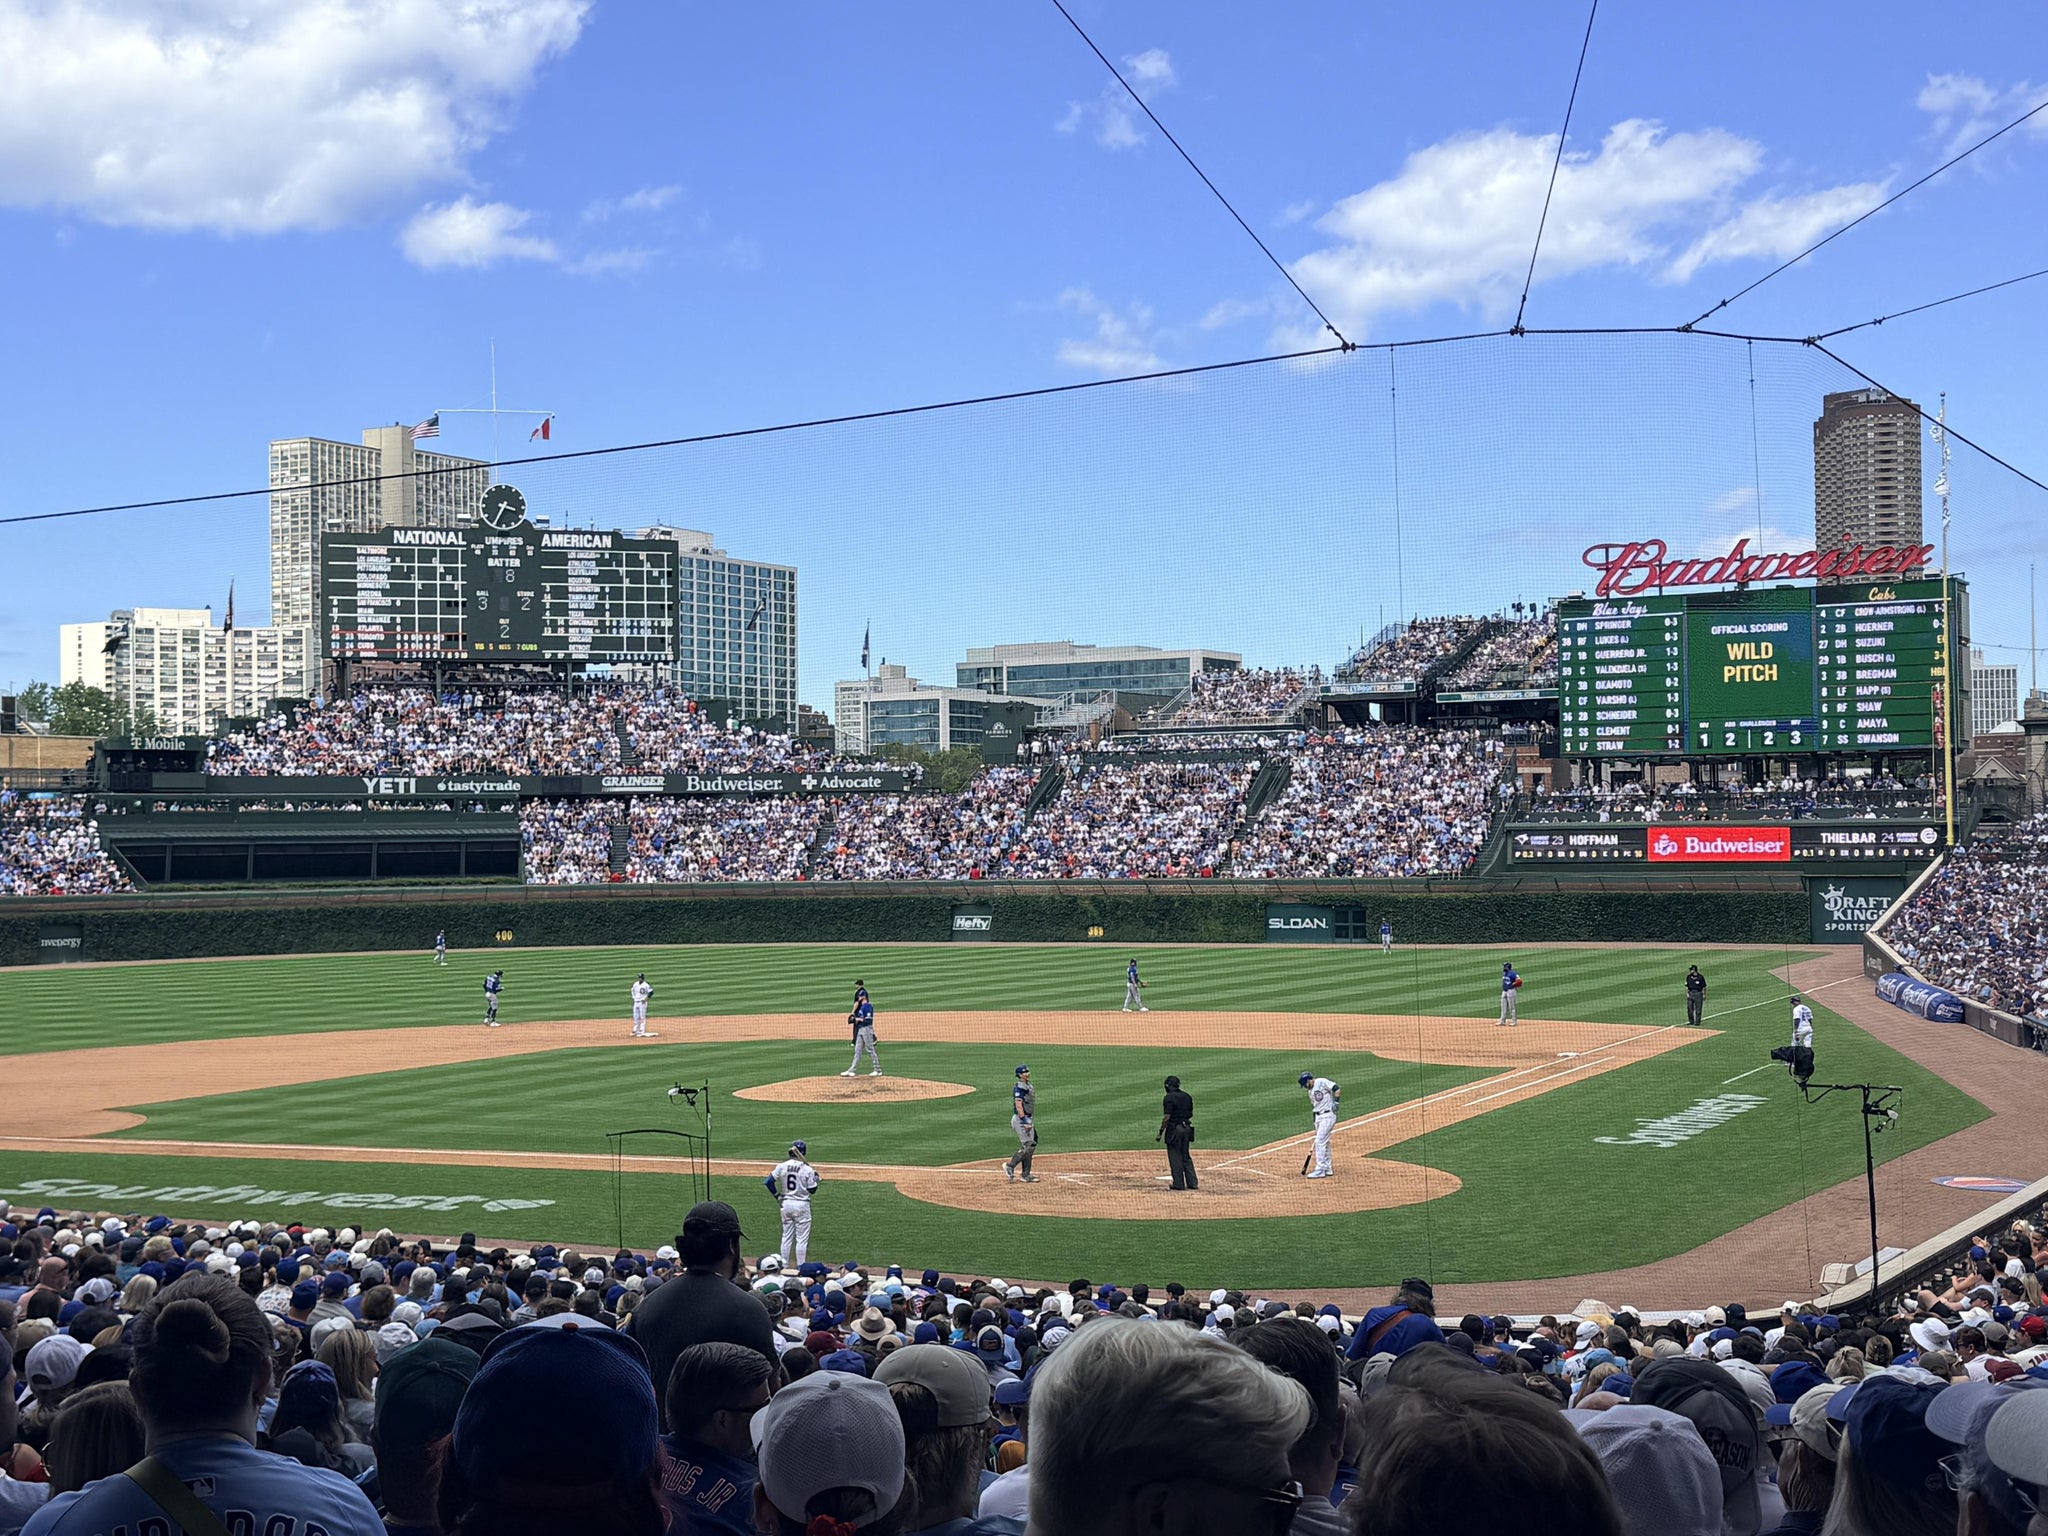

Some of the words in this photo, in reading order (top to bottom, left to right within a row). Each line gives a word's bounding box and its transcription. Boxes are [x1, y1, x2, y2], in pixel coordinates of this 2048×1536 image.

[393, 530, 467, 545] NATIONAL
[485, 536, 524, 546] UMPIRES
[541, 534, 612, 548] AMERICAN
[487, 558, 521, 567] BATTER
[1582, 533, 1934, 596] Budweiser
[505, 569, 515, 583] 8
[1868, 587, 1896, 600] Cubs
[478, 597, 488, 610] 3
[521, 597, 531, 611] 2
[1592, 602, 1618, 616] Blue
[1621, 601, 1648, 618] Jays
[1820, 609, 1826, 618] 4
[1835, 609, 1846, 617] CF
[1564, 623, 1569, 631] 4
[1577, 622, 1587, 631] DH
[1595, 620, 1631, 630] SPRINGER
[1665, 618, 1678, 626] 0-3
[1711, 625, 1748, 635] OFFICIAL
[1750, 622, 1788, 633] SCORING
[1820, 625, 1826, 634] 2
[1835, 624, 1846, 633] 2B
[1855, 622, 1894, 632] HOERNER
[500, 624, 510, 639] 2
[1562, 638, 1571, 646] 38
[1578, 637, 1587, 646] RF
[1595, 636, 1619, 645] LUKES
[1665, 632, 1678, 641] 0-3
[1819, 640, 1829, 649] 27
[1835, 639, 1847, 648] DH
[1855, 637, 1885, 647] SUZUKI
[1562, 652, 1571, 661] 27
[1578, 651, 1587, 660] 1B
[1595, 650, 1635, 659] GUERRERO
[1666, 647, 1678, 656] 1-3
[1726, 642, 1773, 661] WILD
[1819, 656, 1829, 665] 29
[1836, 655, 1847, 664] 1B
[1856, 654, 1884, 663] BUSCH
[1562, 667, 1572, 676] 59
[1579, 666, 1586, 675] C
[1666, 662, 1679, 671] 1-3
[1723, 664, 1778, 683] PITCH
[1821, 671, 1827, 680] 3
[1836, 671, 1847, 680] 3B
[1856, 669, 1897, 679] BREGMAN
[1564, 682, 1570, 691] 7
[1578, 681, 1588, 690] 3B
[1595, 680, 1632, 689] OKAMOTO
[1666, 677, 1679, 687] 0-2
[1821, 687, 1828, 696] 8
[1837, 687, 1847, 696] LF
[1856, 685, 1879, 695] HAPP
[1565, 697, 1570, 706] 5
[1578, 696, 1588, 705] CF
[1596, 695, 1627, 705] VARSHO
[1667, 693, 1679, 702] 1-3
[1822, 703, 1828, 713] 6
[1837, 703, 1848, 712] RF
[1856, 702, 1882, 712] SHAW
[1562, 712, 1572, 722] 36
[1578, 712, 1588, 721] 2B
[1596, 710, 1637, 720] SCHNEIDER
[1666, 709, 1679, 718] 0-3
[1822, 720, 1828, 729] 9
[1839, 719, 1846, 729] C
[1857, 718, 1888, 728] AMAYA
[1563, 727, 1573, 737] 22
[1578, 727, 1589, 737] SS
[1596, 726, 1631, 736] CLEMENT
[1667, 725, 1680, 734] 0-1
[144, 738, 186, 750] Mobile
[1565, 742, 1571, 751] 3
[1579, 742, 1589, 751] LF
[1597, 741, 1624, 750] STRAW
[1668, 739, 1680, 749] 1-2
[1700, 733, 1709, 747] 1
[1725, 732, 1736, 746] 2
[1763, 731, 1774, 745] 2
[1790, 730, 1801, 744] 3
[1822, 735, 1828, 744] 7
[1837, 735, 1849, 744] SS
[1857, 733, 1899, 743] SWANSON
[362, 777, 417, 794] YETI
[448, 780, 521, 794] tastytrade
[602, 776, 666, 787] GRAINGER
[820, 776, 881, 789] Advocate
[1569, 835, 1618, 846] HOFFMAN
[1820, 833, 1876, 843] THIELBAR
[1881, 833, 1894, 843] 24
[1684, 837, 1785, 853] Budweiser
[1824, 896, 1891, 911] DRAFT
[955, 918, 989, 929] Hefty
[495, 930, 513, 941] 400
[787, 1174, 797, 1191] 6
[0, 1178, 489, 1211] Southwest
[697, 1478, 737, 1514] JR
